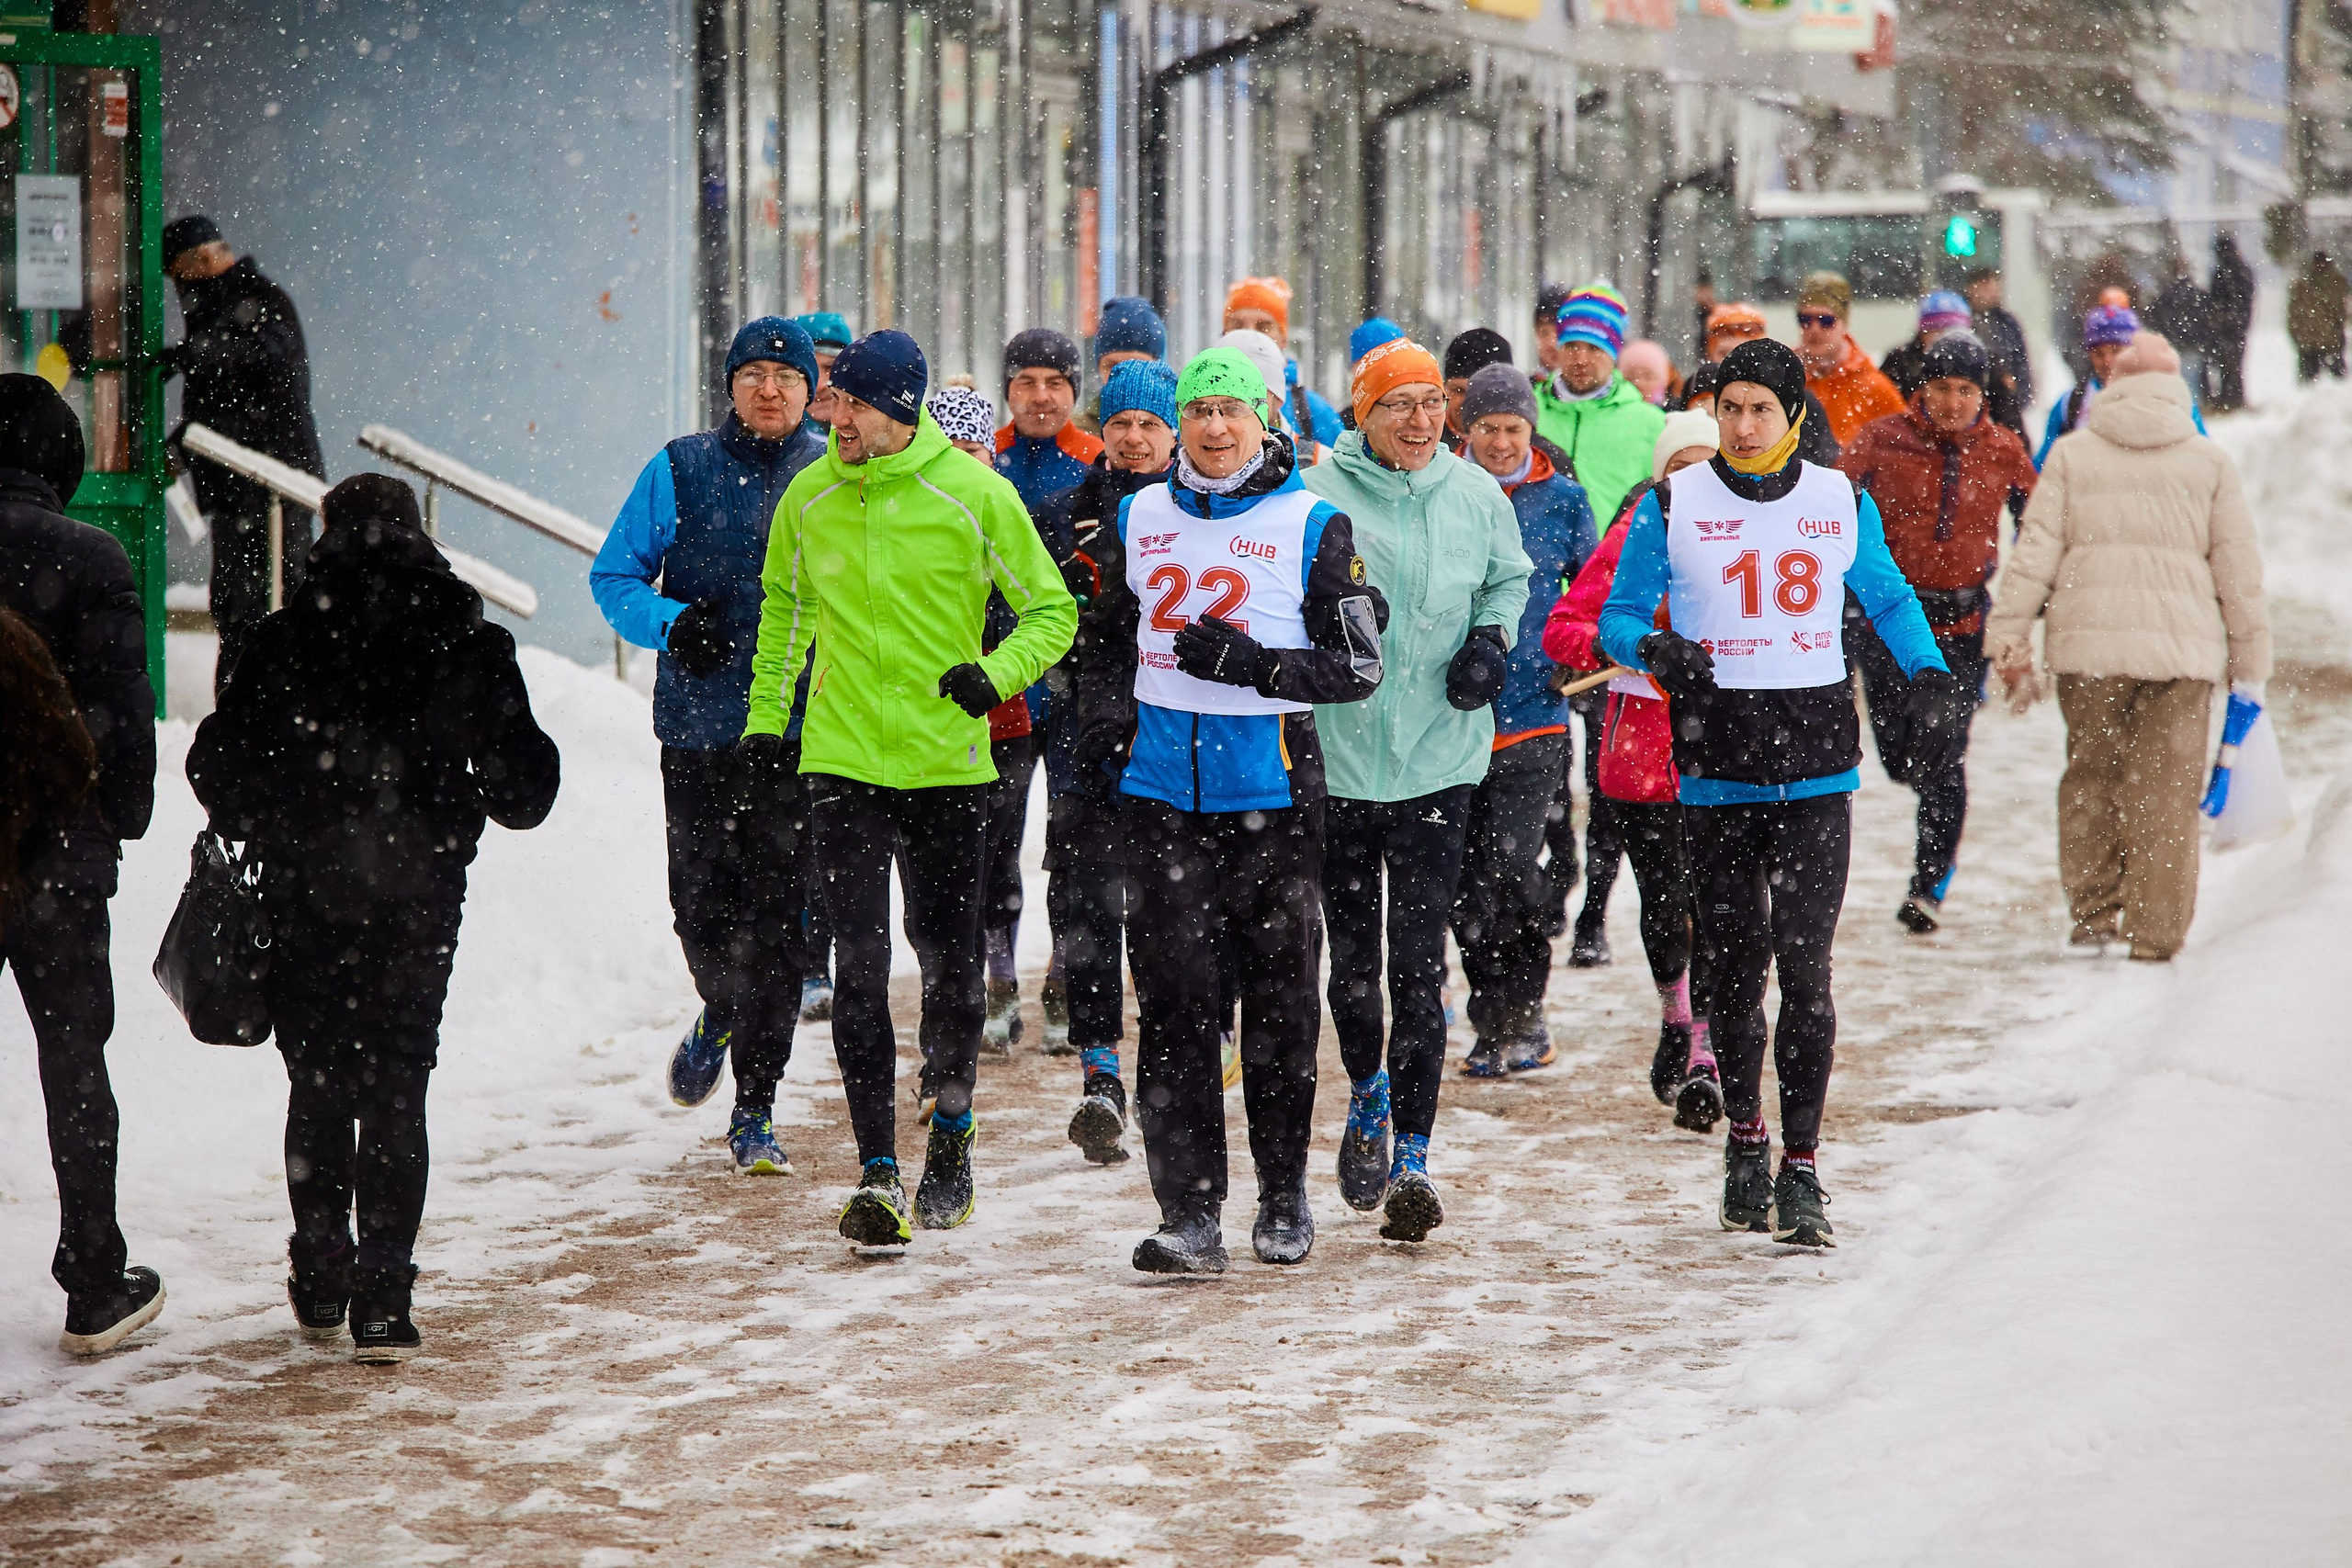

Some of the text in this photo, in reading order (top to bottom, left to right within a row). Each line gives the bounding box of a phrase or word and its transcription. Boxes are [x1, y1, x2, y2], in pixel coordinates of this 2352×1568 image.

[1723, 549, 1823, 619] 18
[1147, 563, 1250, 636] 22
[1717, 638, 1773, 648] ВЕРТОЛЕТЫ
[1146, 651, 1178, 662] ВЕРТОЛЕ
[1717, 648, 1755, 656] РОССИИ
[1147, 660, 1175, 671] РОССИИ
